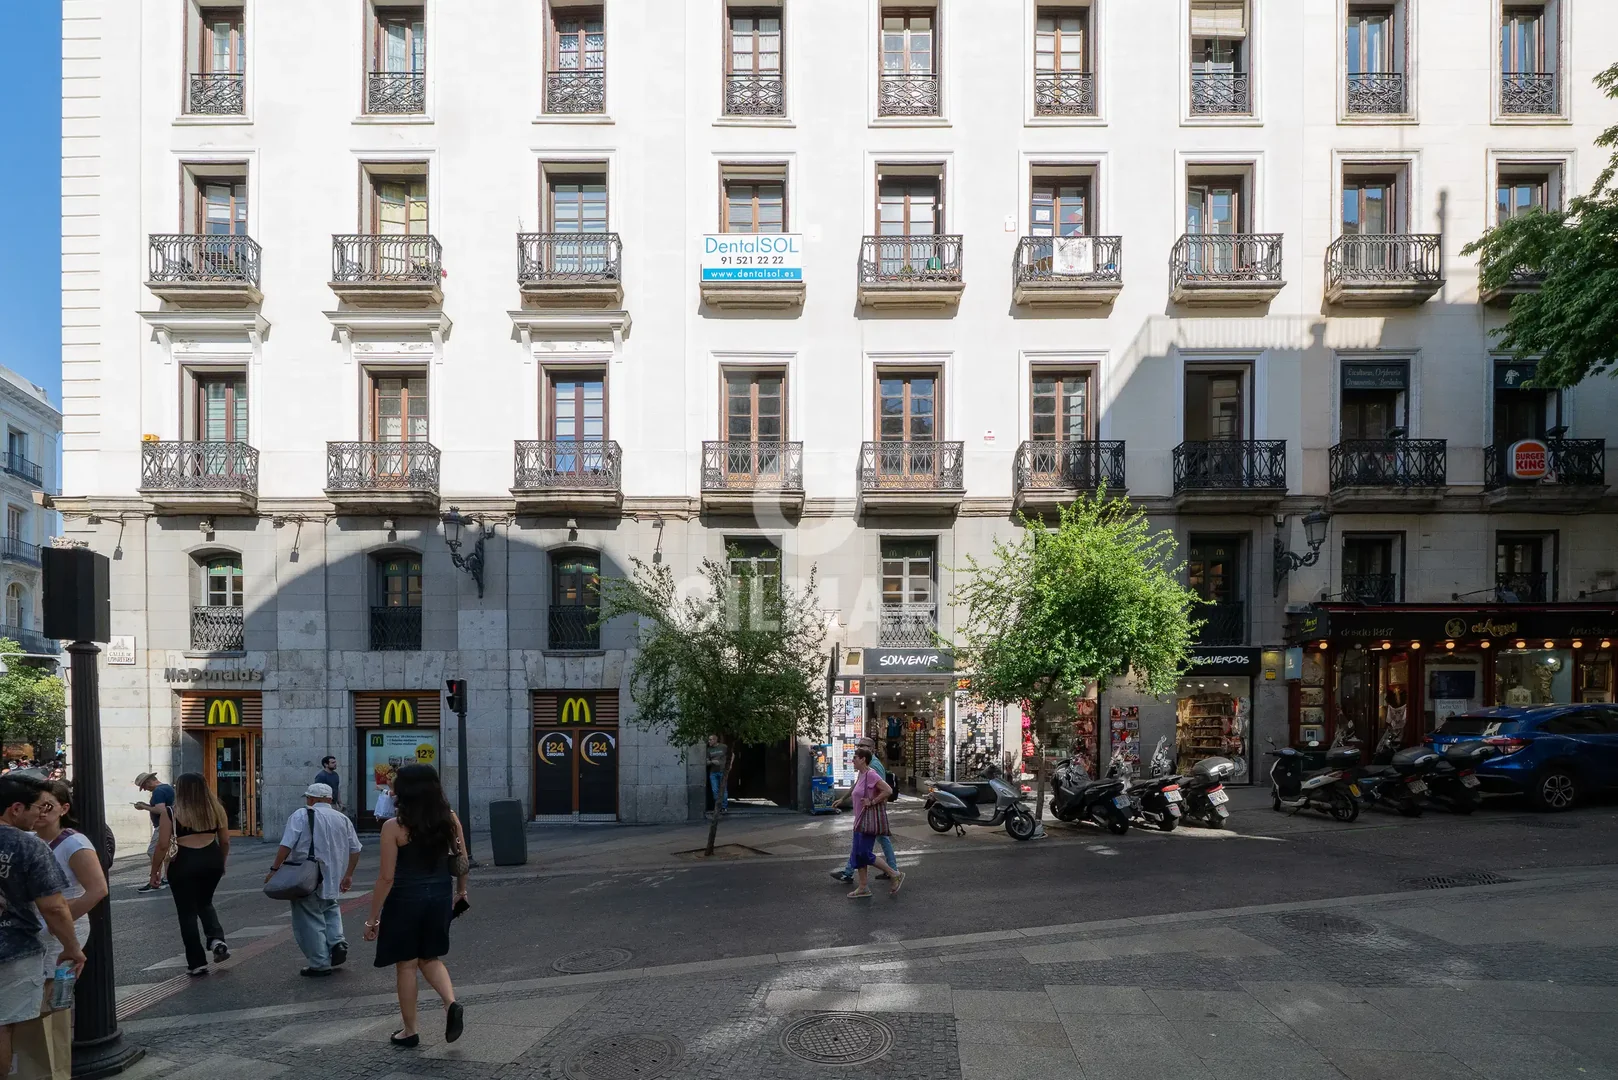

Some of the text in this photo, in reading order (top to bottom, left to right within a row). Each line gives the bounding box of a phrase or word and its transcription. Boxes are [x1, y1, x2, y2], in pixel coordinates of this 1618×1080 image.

[705, 235, 799, 254] DentalSOL
[721, 256, 784, 265] 91 521 22 22
[710, 269, 795, 278] www.dentalsol.es
[1515, 460, 1545, 470] KING
[879, 655, 939, 667] SOUVENIR
[164, 667, 263, 682] McDonald's
[549, 741, 565, 753] 24
[592, 741, 608, 753] 24
